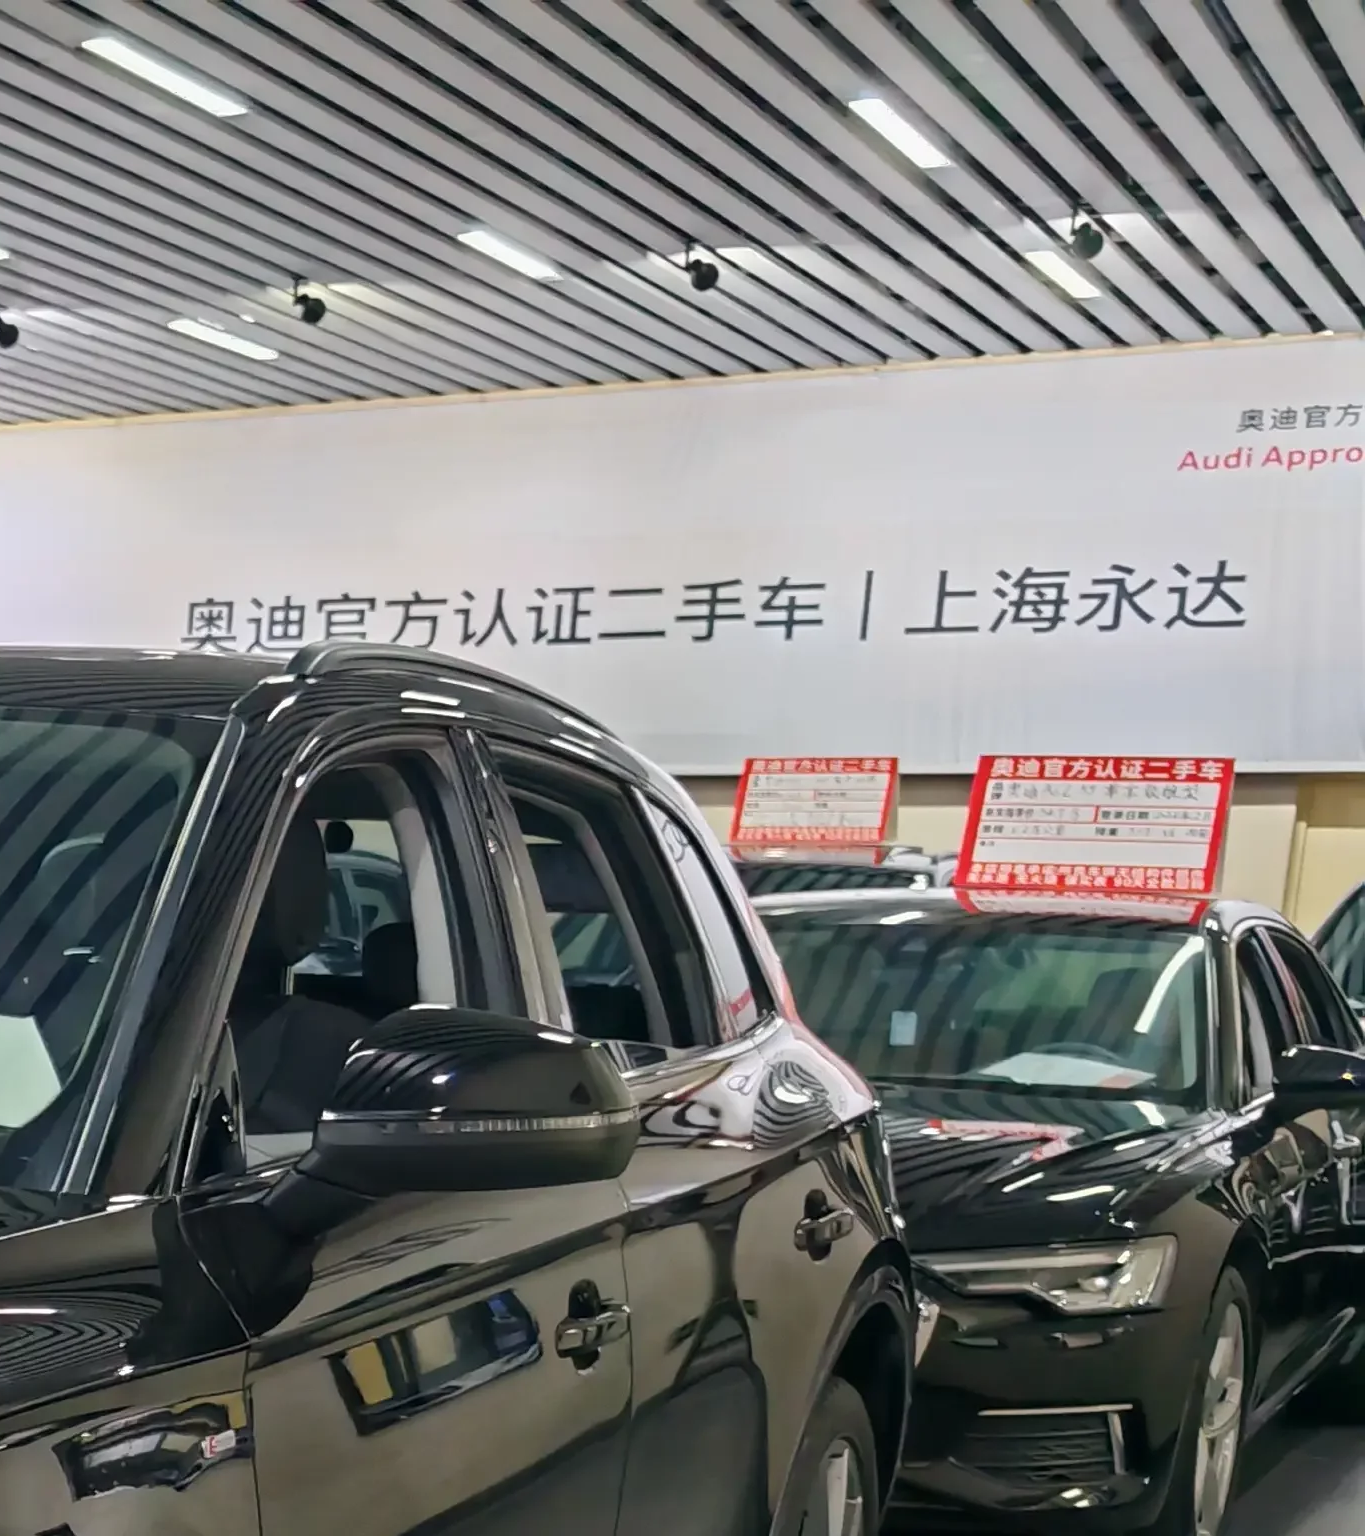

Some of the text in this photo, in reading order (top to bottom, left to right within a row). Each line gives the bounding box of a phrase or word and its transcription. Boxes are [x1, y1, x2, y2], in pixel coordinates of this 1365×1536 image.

[1235, 403, 1364, 434] 奥迪官方
[1176, 446, 1365, 472] Audi Appro
[180, 576, 826, 654] 奥迪官方认证二手车
[904, 560, 1248, 634] 上海永达
[990, 757, 1225, 781] 奥迪官方认证二手车
